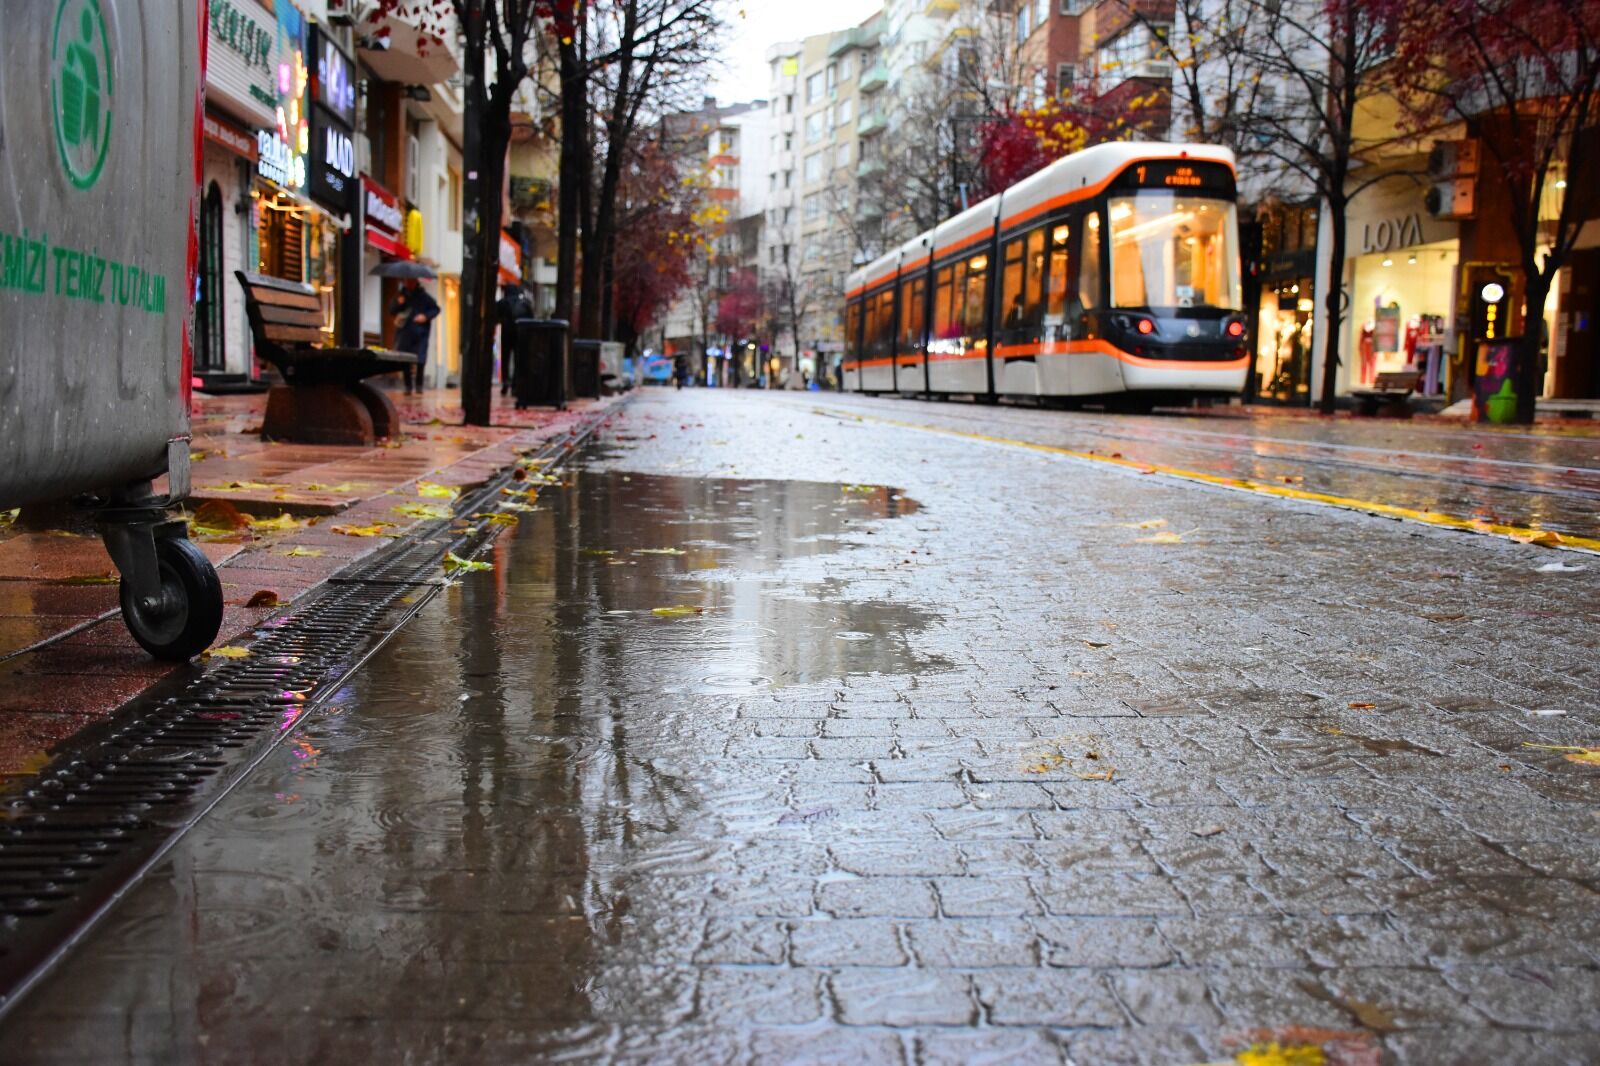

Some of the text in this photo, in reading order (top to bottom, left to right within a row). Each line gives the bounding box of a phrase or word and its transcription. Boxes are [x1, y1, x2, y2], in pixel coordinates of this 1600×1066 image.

[1361, 213, 1424, 254] LOYA
[0, 228, 165, 313] MİZİ TEMİZ TUTALIM
